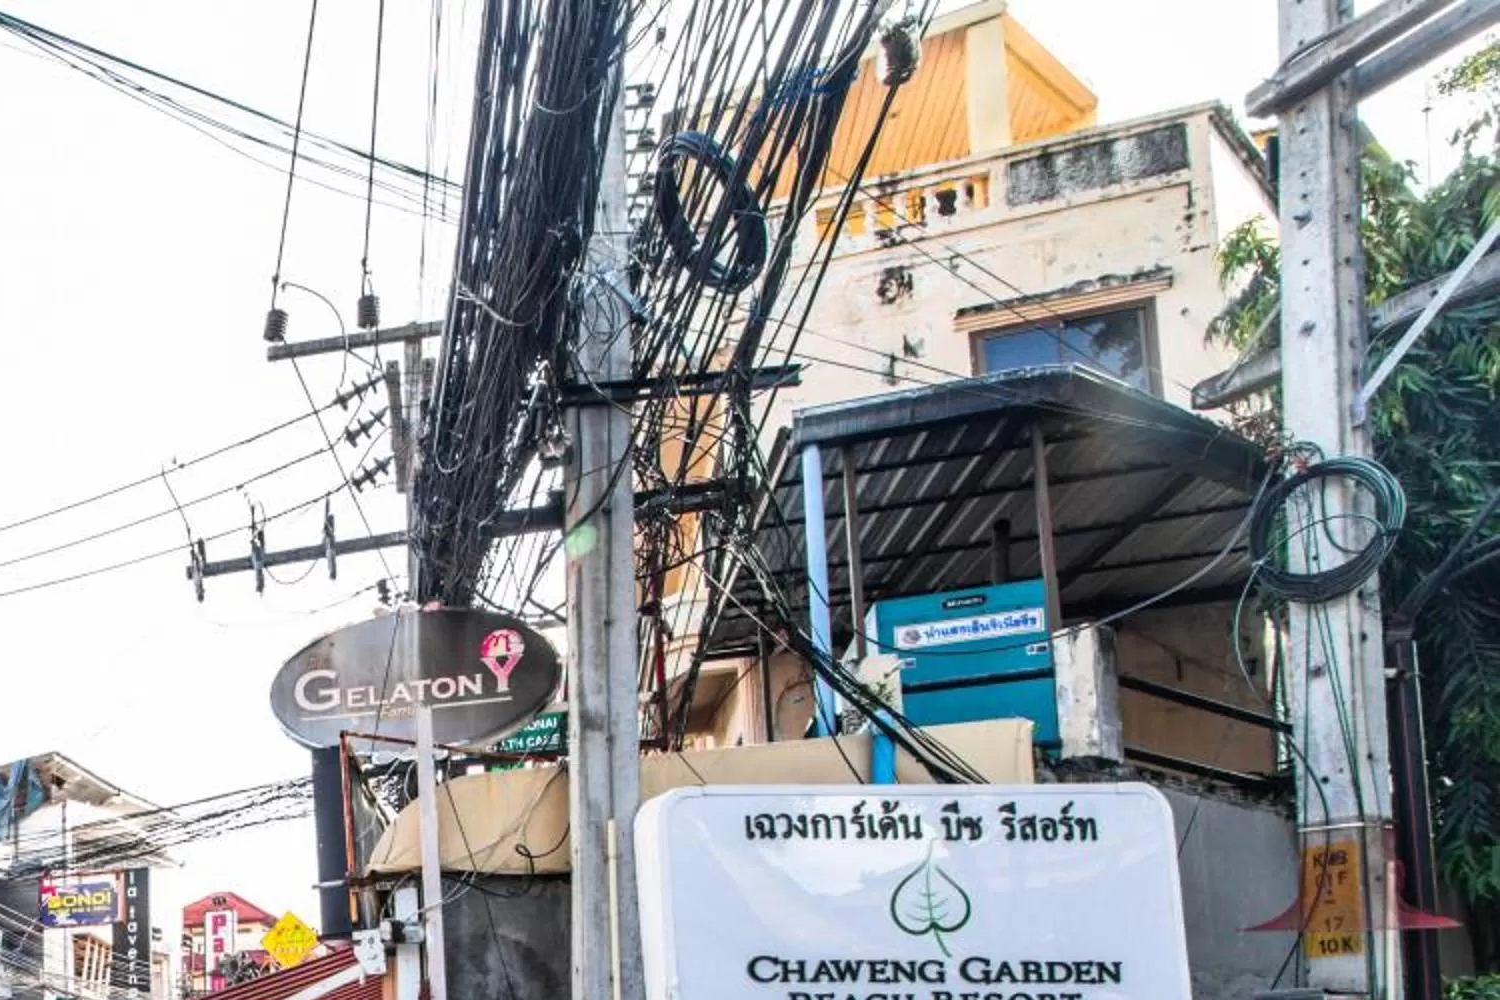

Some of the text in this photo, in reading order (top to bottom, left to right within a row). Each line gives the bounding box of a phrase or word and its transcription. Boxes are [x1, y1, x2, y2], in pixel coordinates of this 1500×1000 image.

[745, 800, 1099, 842] เฉวงการ์เด้น บีช รีสอร์ท
[747, 956, 1122, 984] CHAWENG GARDEN
